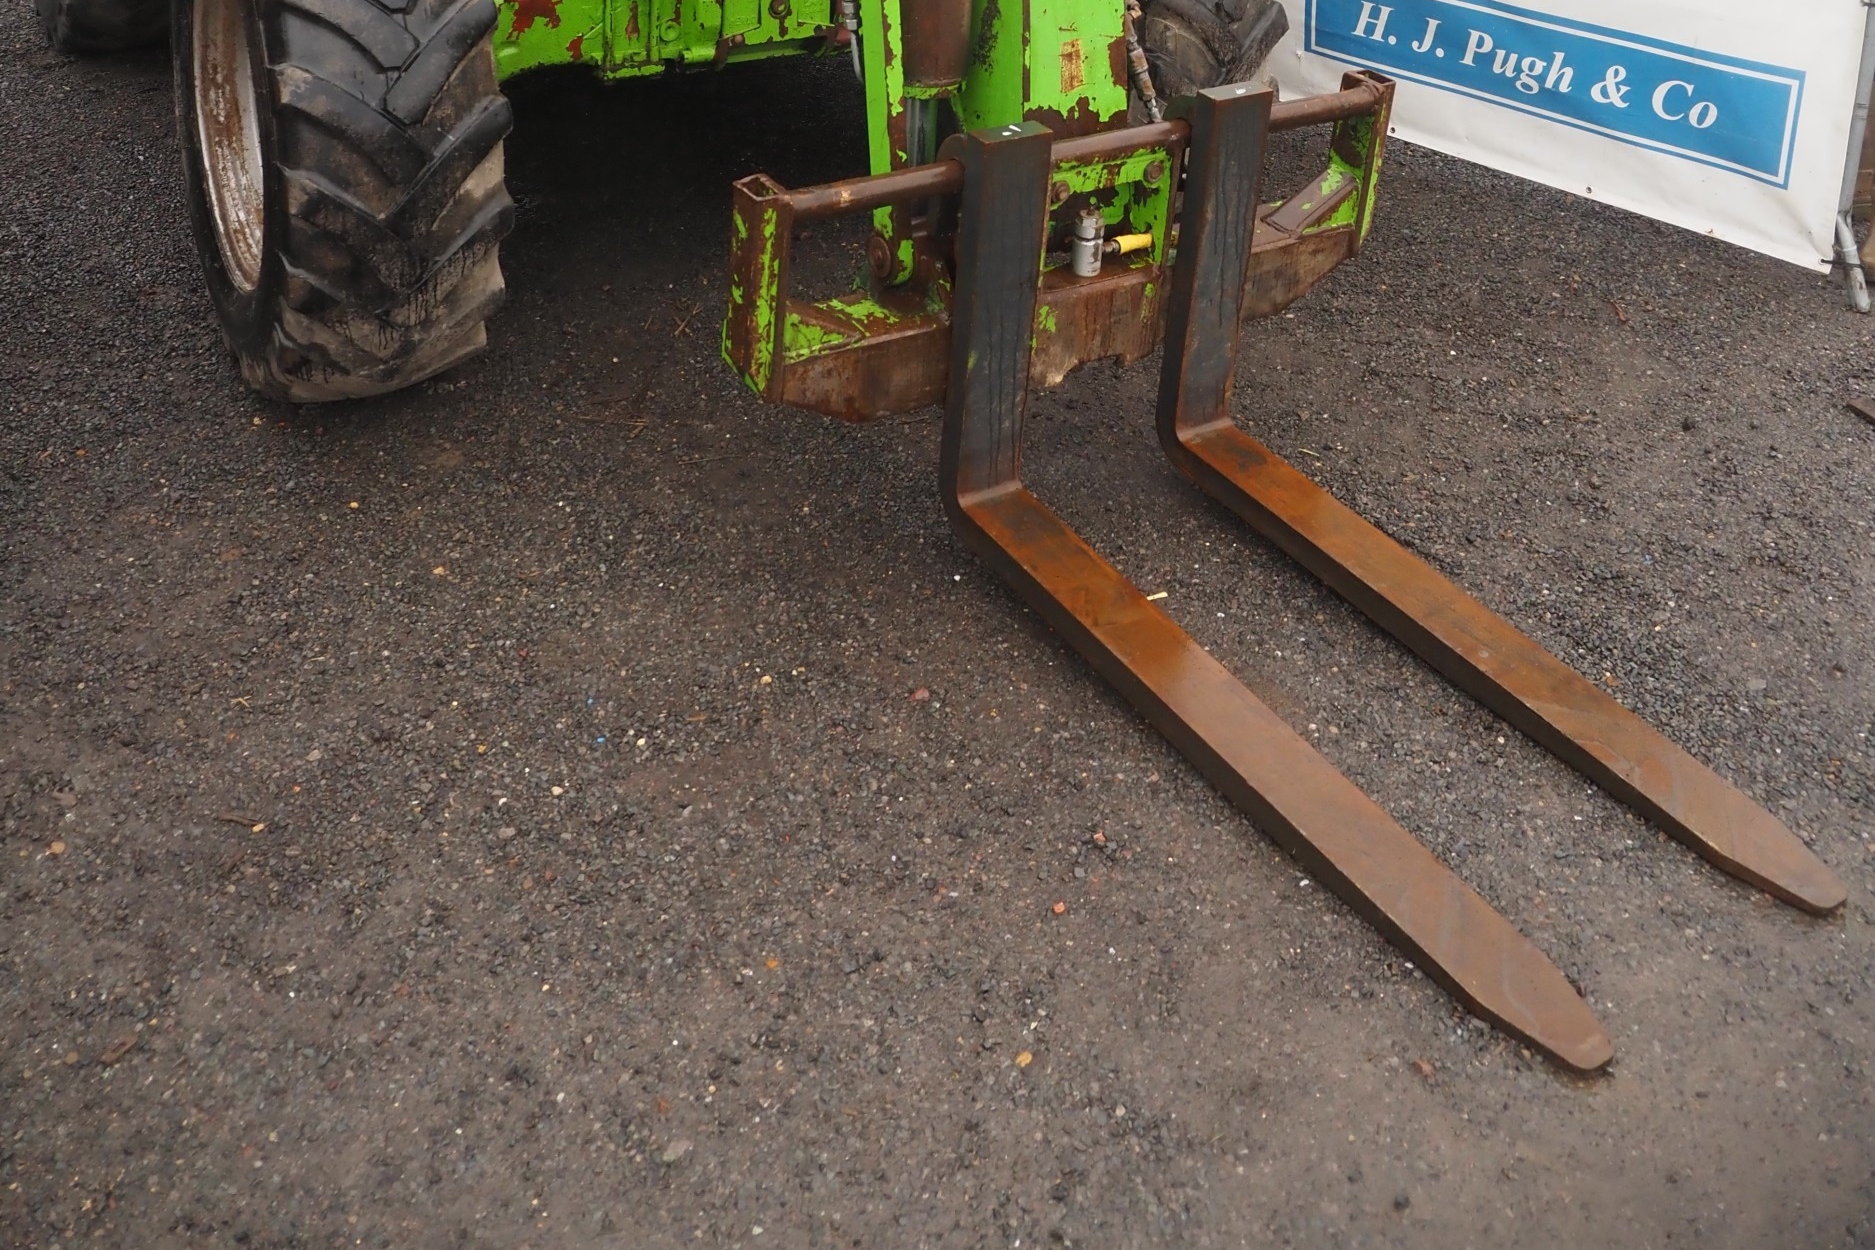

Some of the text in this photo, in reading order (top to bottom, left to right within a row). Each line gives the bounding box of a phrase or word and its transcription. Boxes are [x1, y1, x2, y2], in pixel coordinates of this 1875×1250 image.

[1350, 0, 1719, 129] H. J. Pugh & Co
